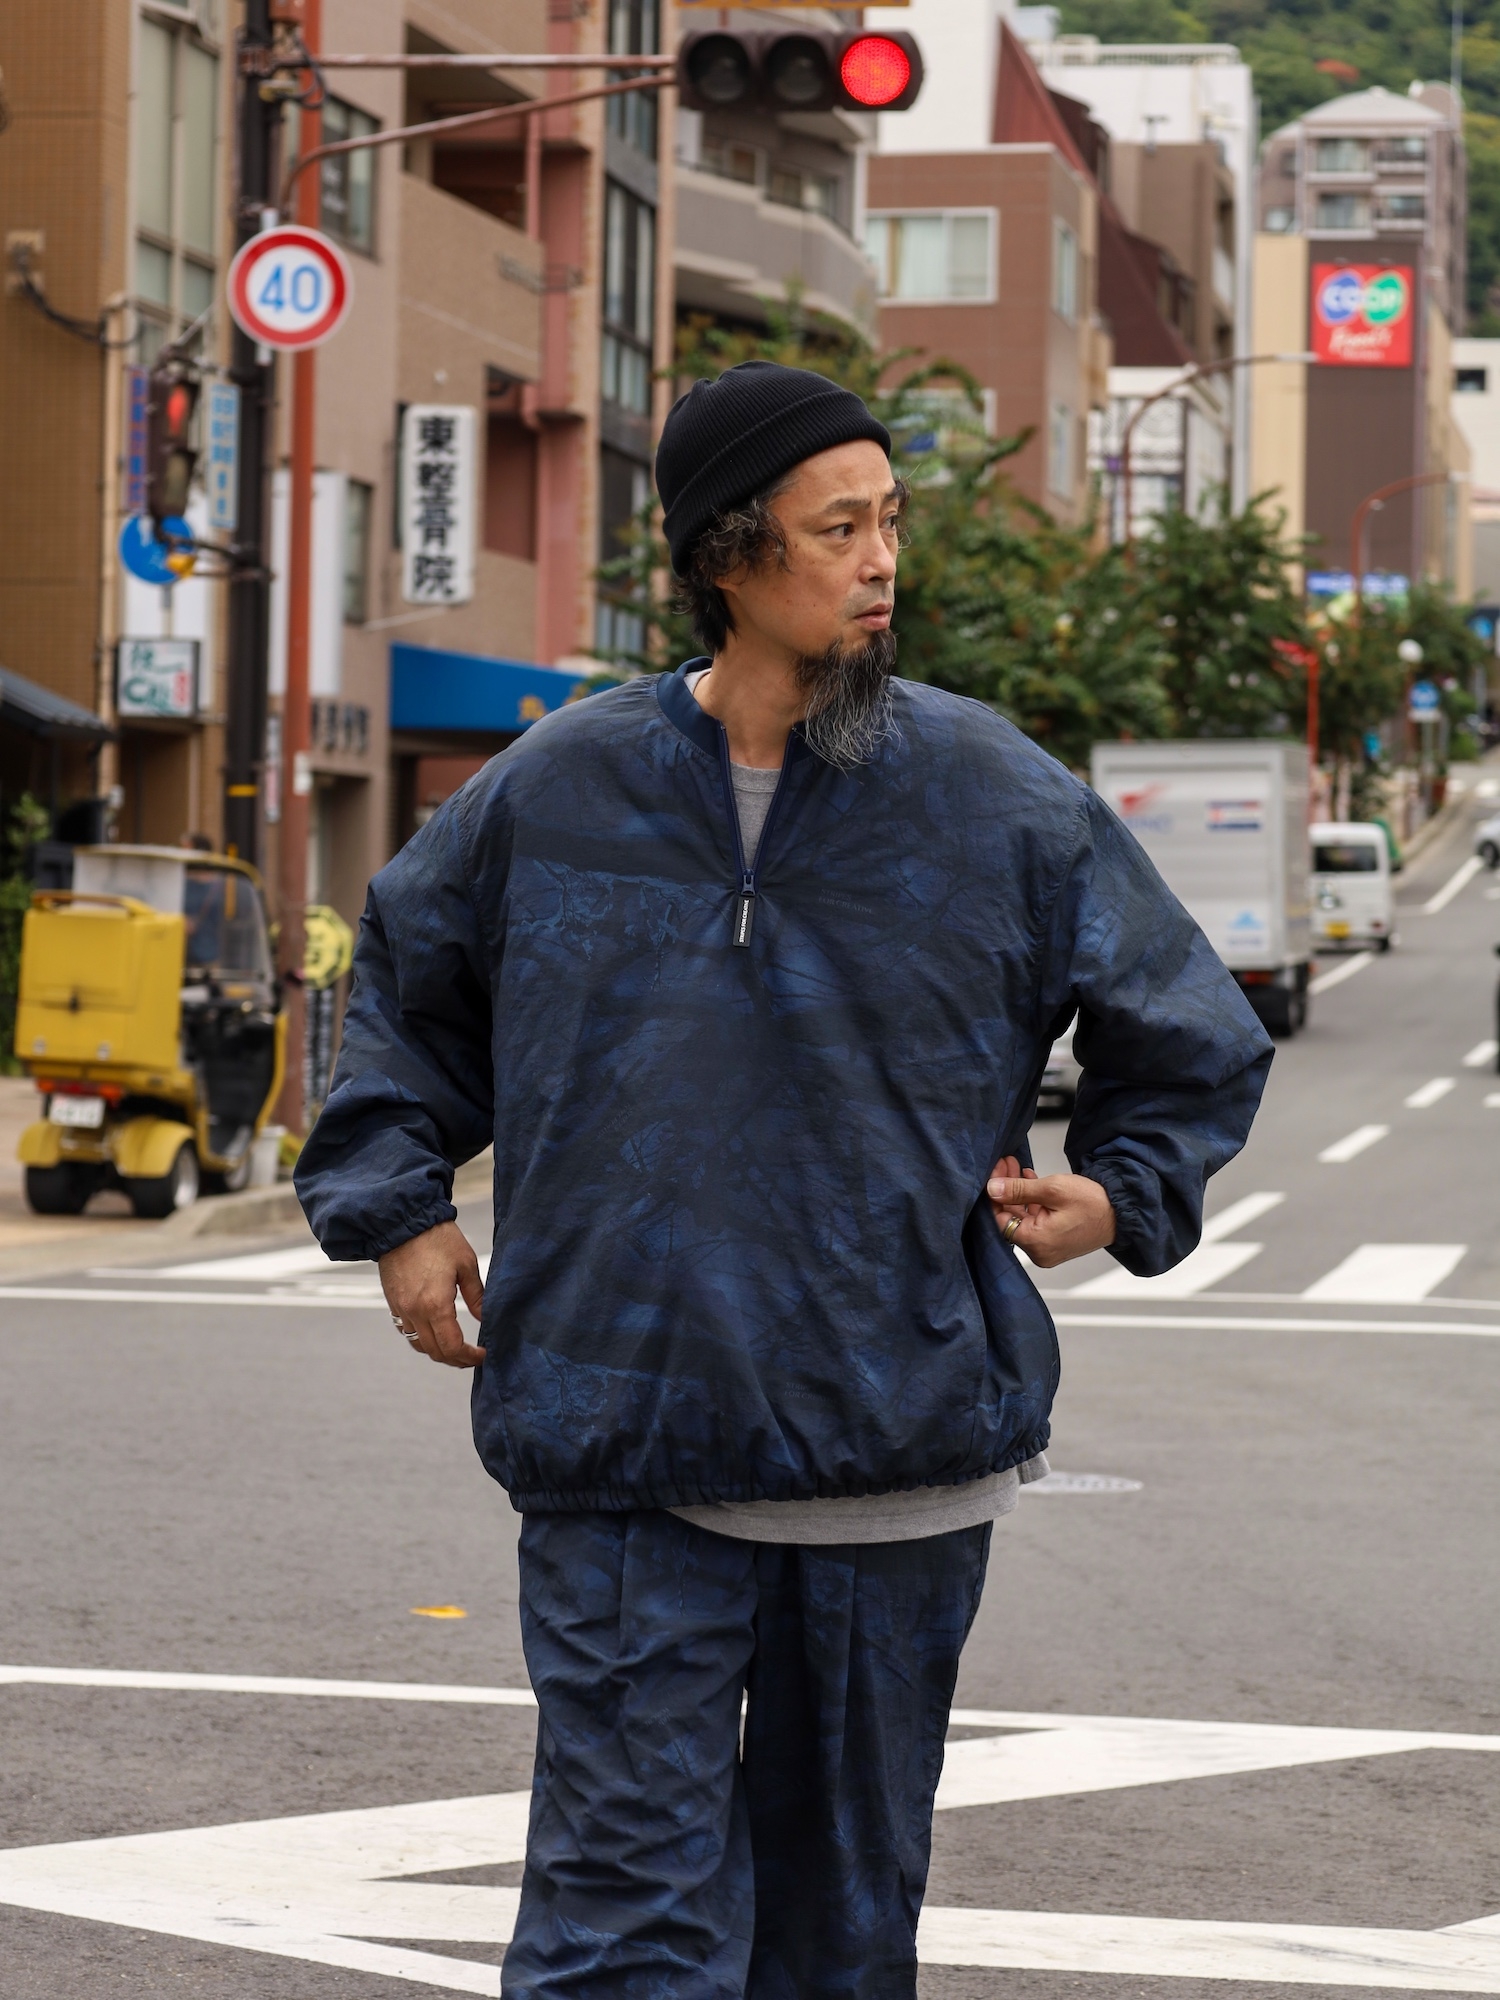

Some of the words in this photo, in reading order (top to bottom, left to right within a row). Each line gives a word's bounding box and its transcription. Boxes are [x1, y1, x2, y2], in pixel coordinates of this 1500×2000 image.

[258, 264, 321, 313] 40
[413, 415, 456, 597] 東整骨院
